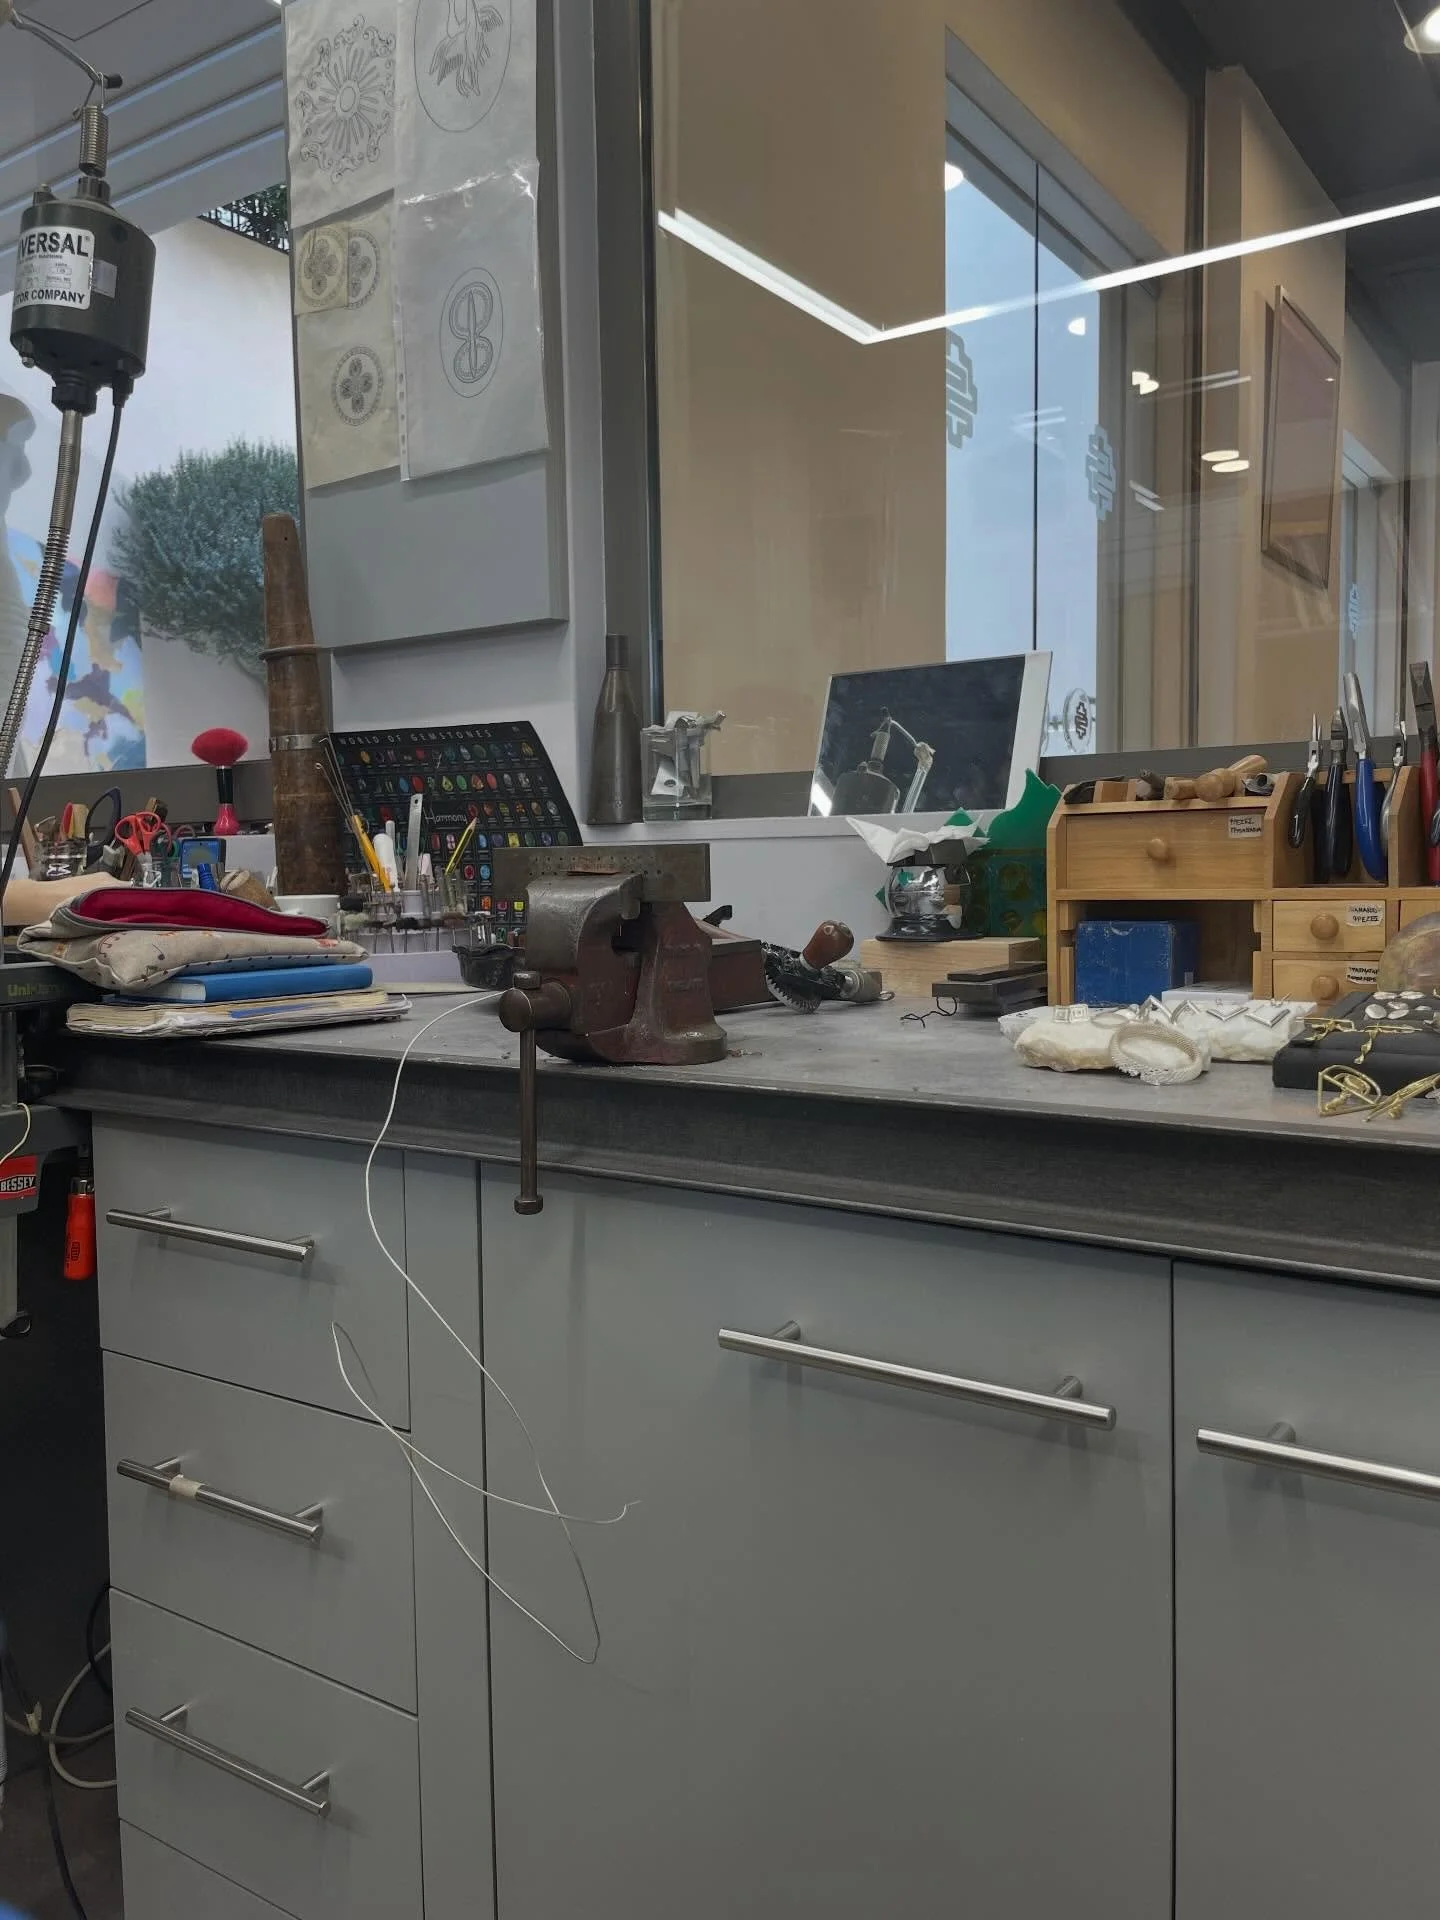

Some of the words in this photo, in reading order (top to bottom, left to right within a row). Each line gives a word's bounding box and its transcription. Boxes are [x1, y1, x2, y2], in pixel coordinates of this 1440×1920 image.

[31, 289, 85, 304] COMPANY
[339, 735, 381, 746] WORLD
[387, 733, 402, 744] OF
[411, 729, 493, 742] GEMSTONES
[422, 807, 468, 825] Harmony
[0, 1176, 35, 1192] BESSEY
